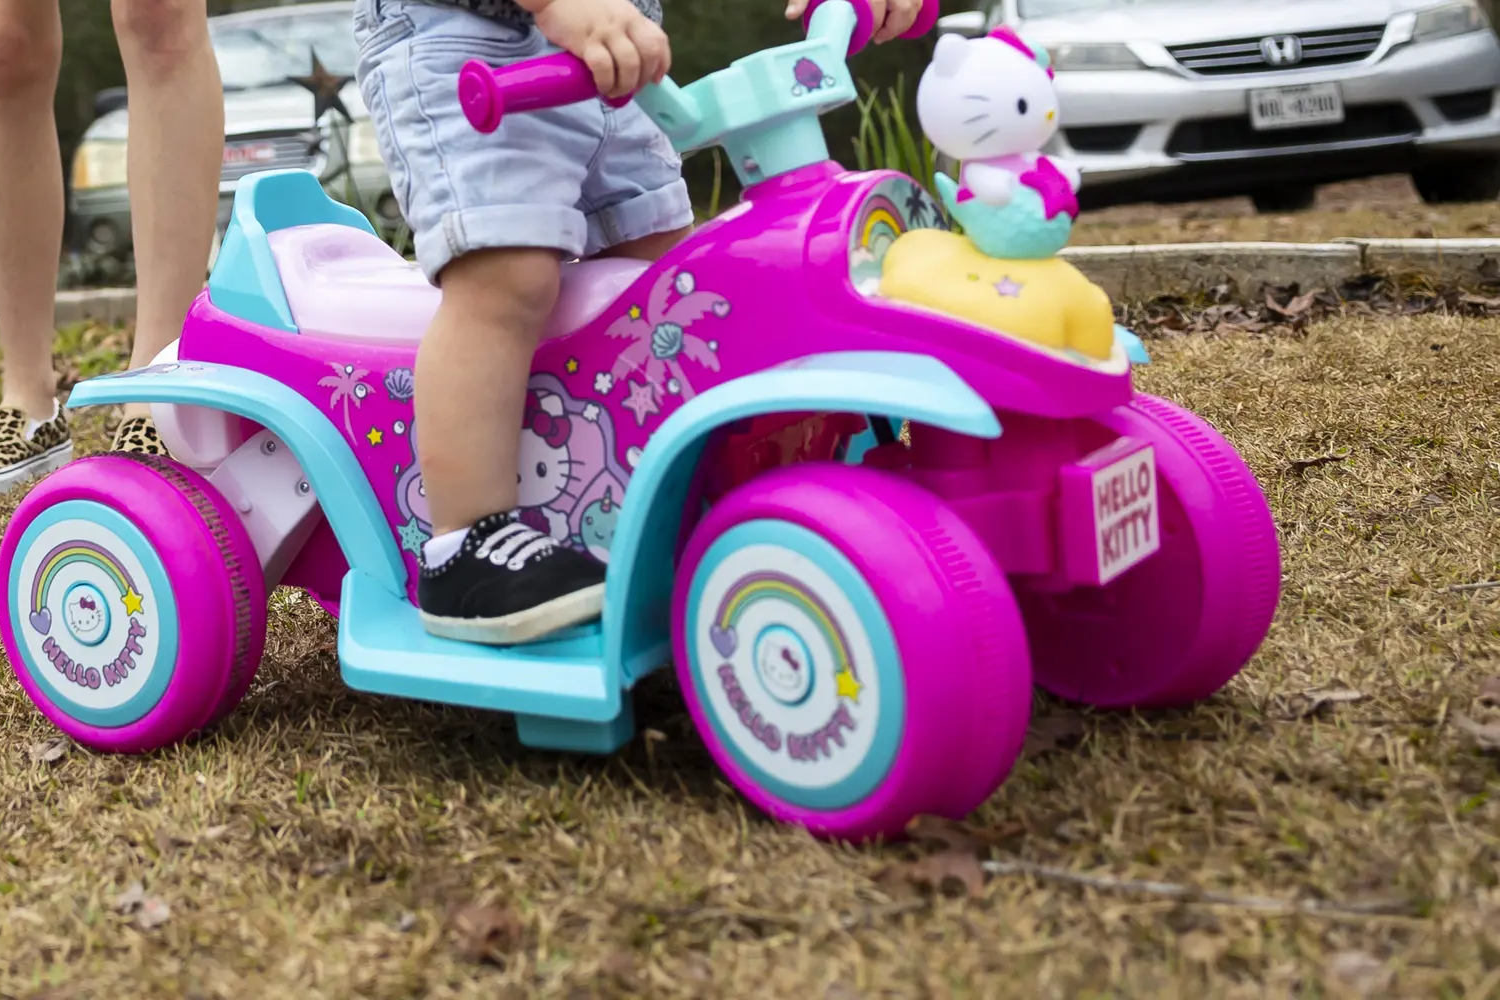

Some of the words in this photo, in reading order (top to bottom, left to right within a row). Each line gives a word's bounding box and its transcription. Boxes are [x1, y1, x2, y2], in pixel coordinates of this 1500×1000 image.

[1098, 462, 1150, 520] HELLO
[1101, 503, 1151, 567] KITTY
[43, 637, 101, 689] HELLO
[103, 618, 146, 686] KITTY
[718, 664, 781, 751] HELLO
[787, 703, 855, 761] KITTY
